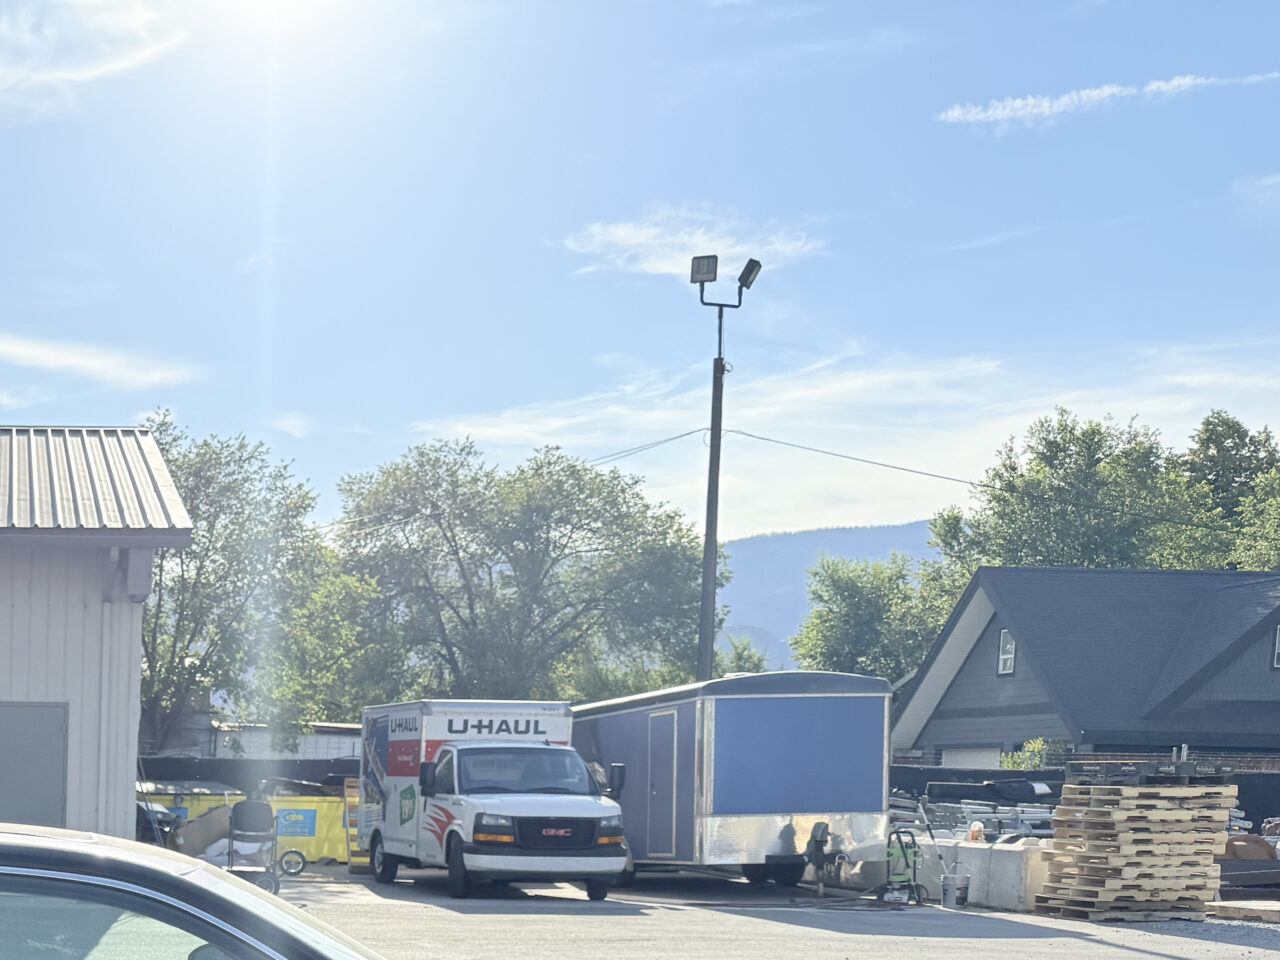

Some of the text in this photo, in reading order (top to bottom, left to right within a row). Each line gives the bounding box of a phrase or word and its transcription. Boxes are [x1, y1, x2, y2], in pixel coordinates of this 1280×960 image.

[391, 717, 418, 733] U-HAUL
[448, 719, 547, 735] U-HAUL
[542, 828, 571, 836] GMC
